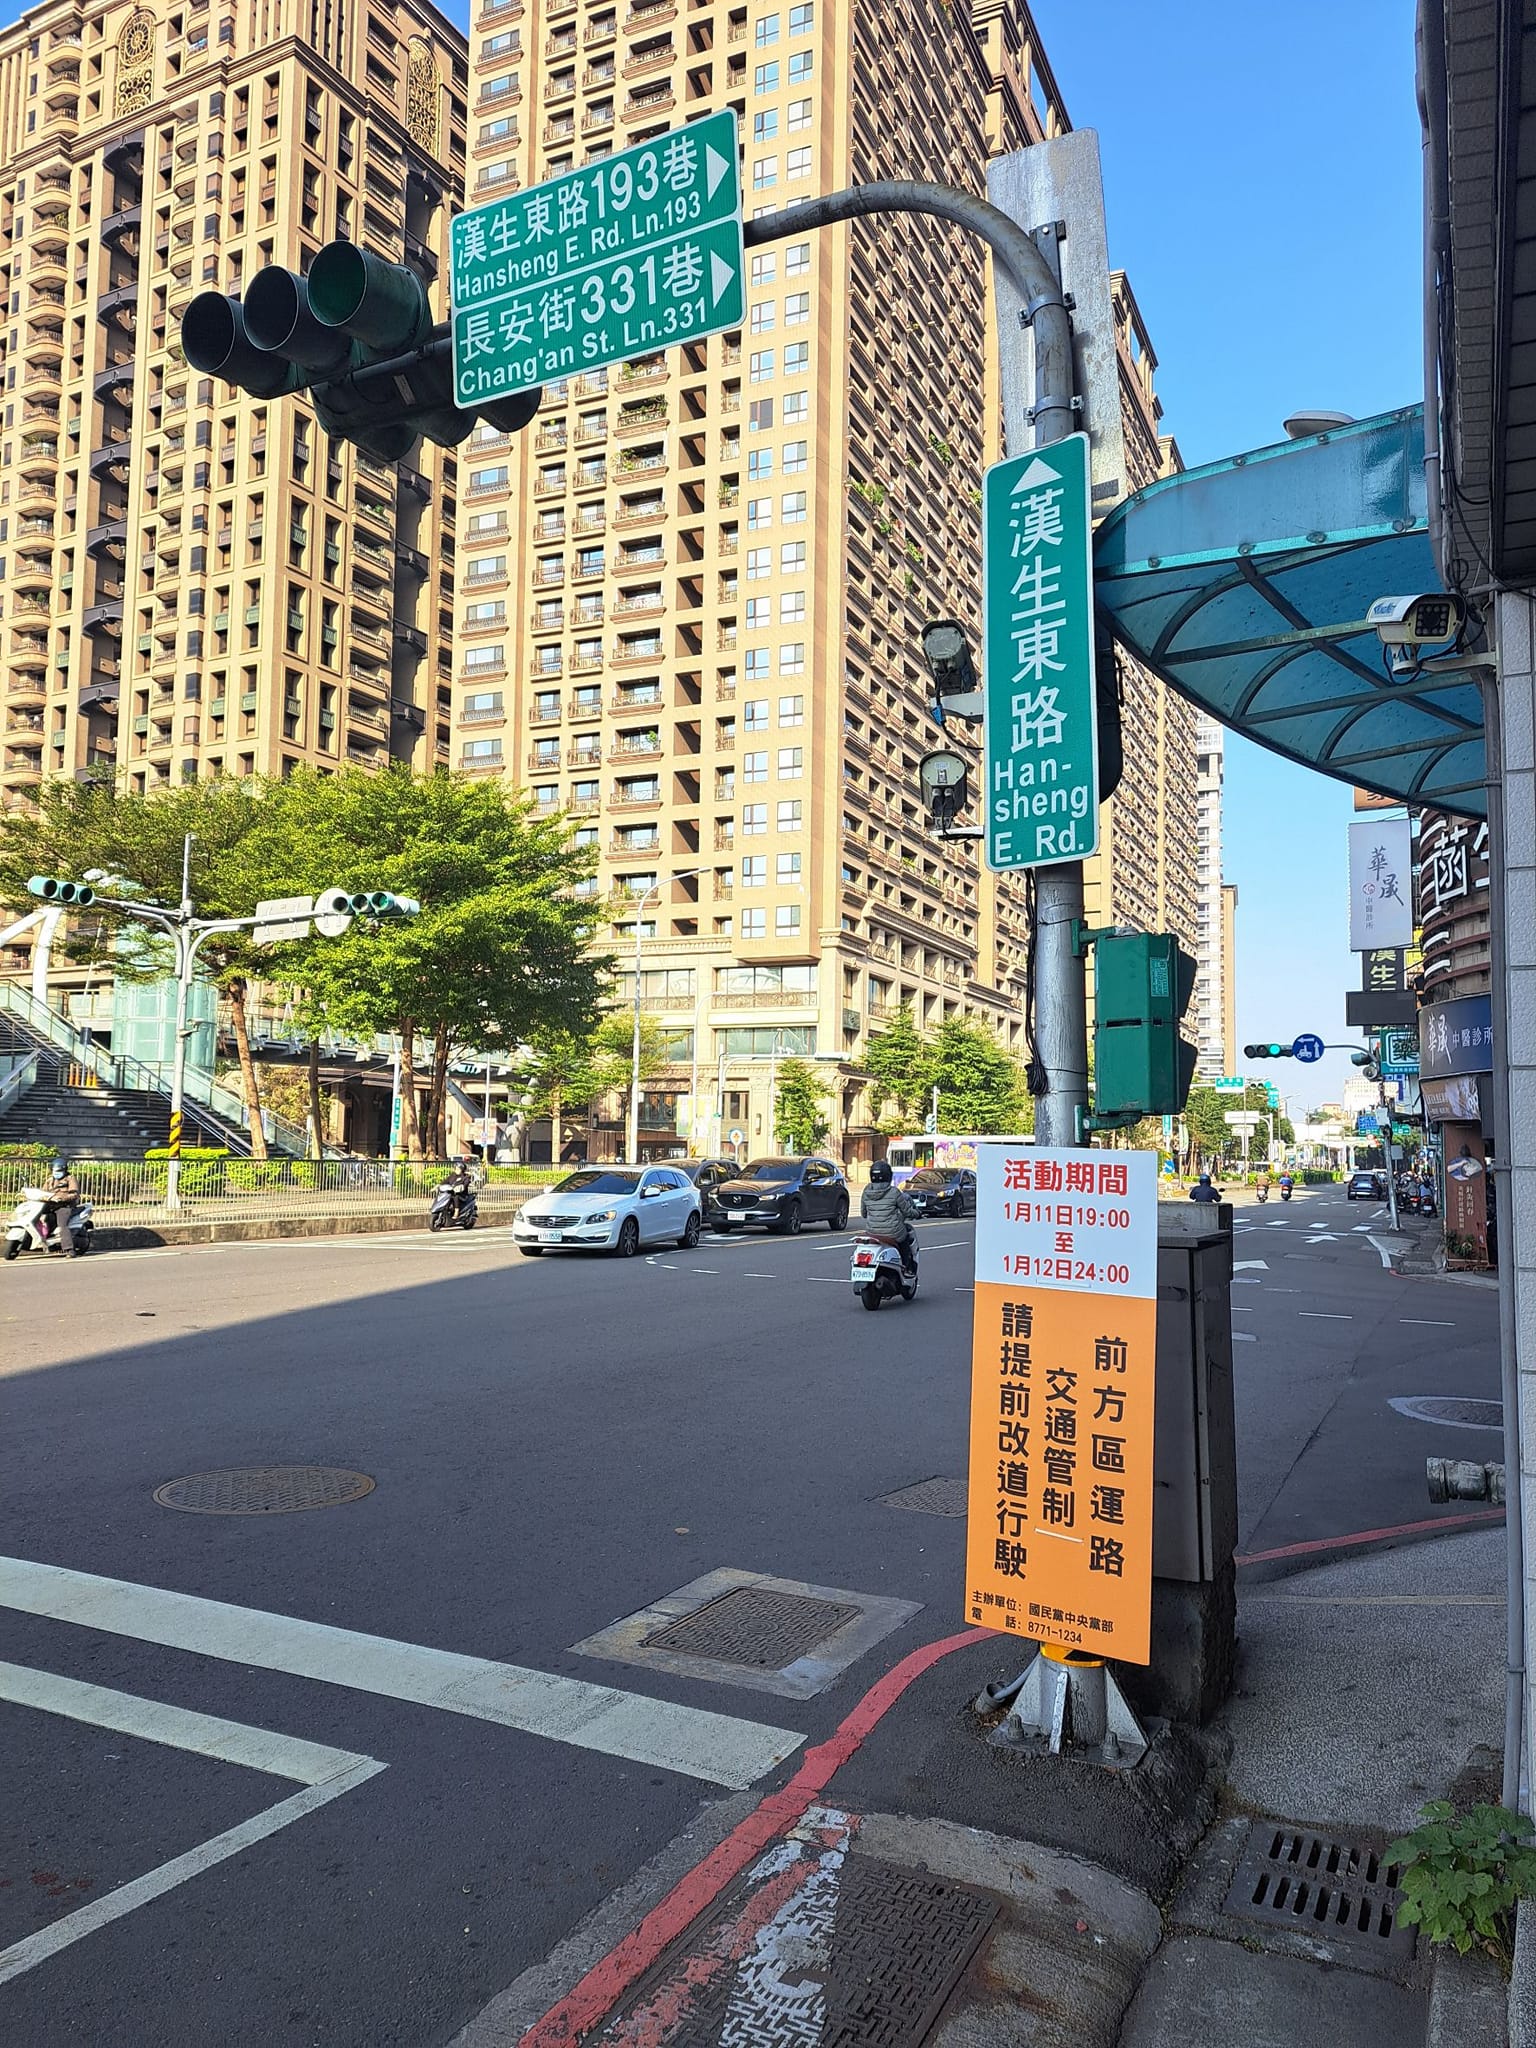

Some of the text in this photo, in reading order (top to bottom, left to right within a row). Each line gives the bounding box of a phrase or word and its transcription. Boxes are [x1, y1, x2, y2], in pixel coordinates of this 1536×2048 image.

[456, 135, 698, 269] 漢生東路193巷
[457, 191, 701, 300] Hansheng E. Rd. Ln.193
[459, 241, 704, 364] 長安街331巷
[460, 297, 706, 395] Chang'an St. Ln.331
[1010, 488, 1068, 754] 漢生東路
[994, 758, 1072, 792] Han-
[994, 783, 1088, 822] sheng
[994, 821, 1085, 863] E. Rd.
[1003, 1159, 1128, 1196] 活動期間
[1004, 1202, 1130, 1228] 1月11日19:00
[1003, 1255, 1129, 1284] 1月12日24:00
[1054, 1231, 1074, 1253] 至
[994, 1302, 1033, 1580] 請提前改道行駛
[1042, 1367, 1077, 1527] 交通管制
[1089, 1335, 1128, 1577] 前方區運路
